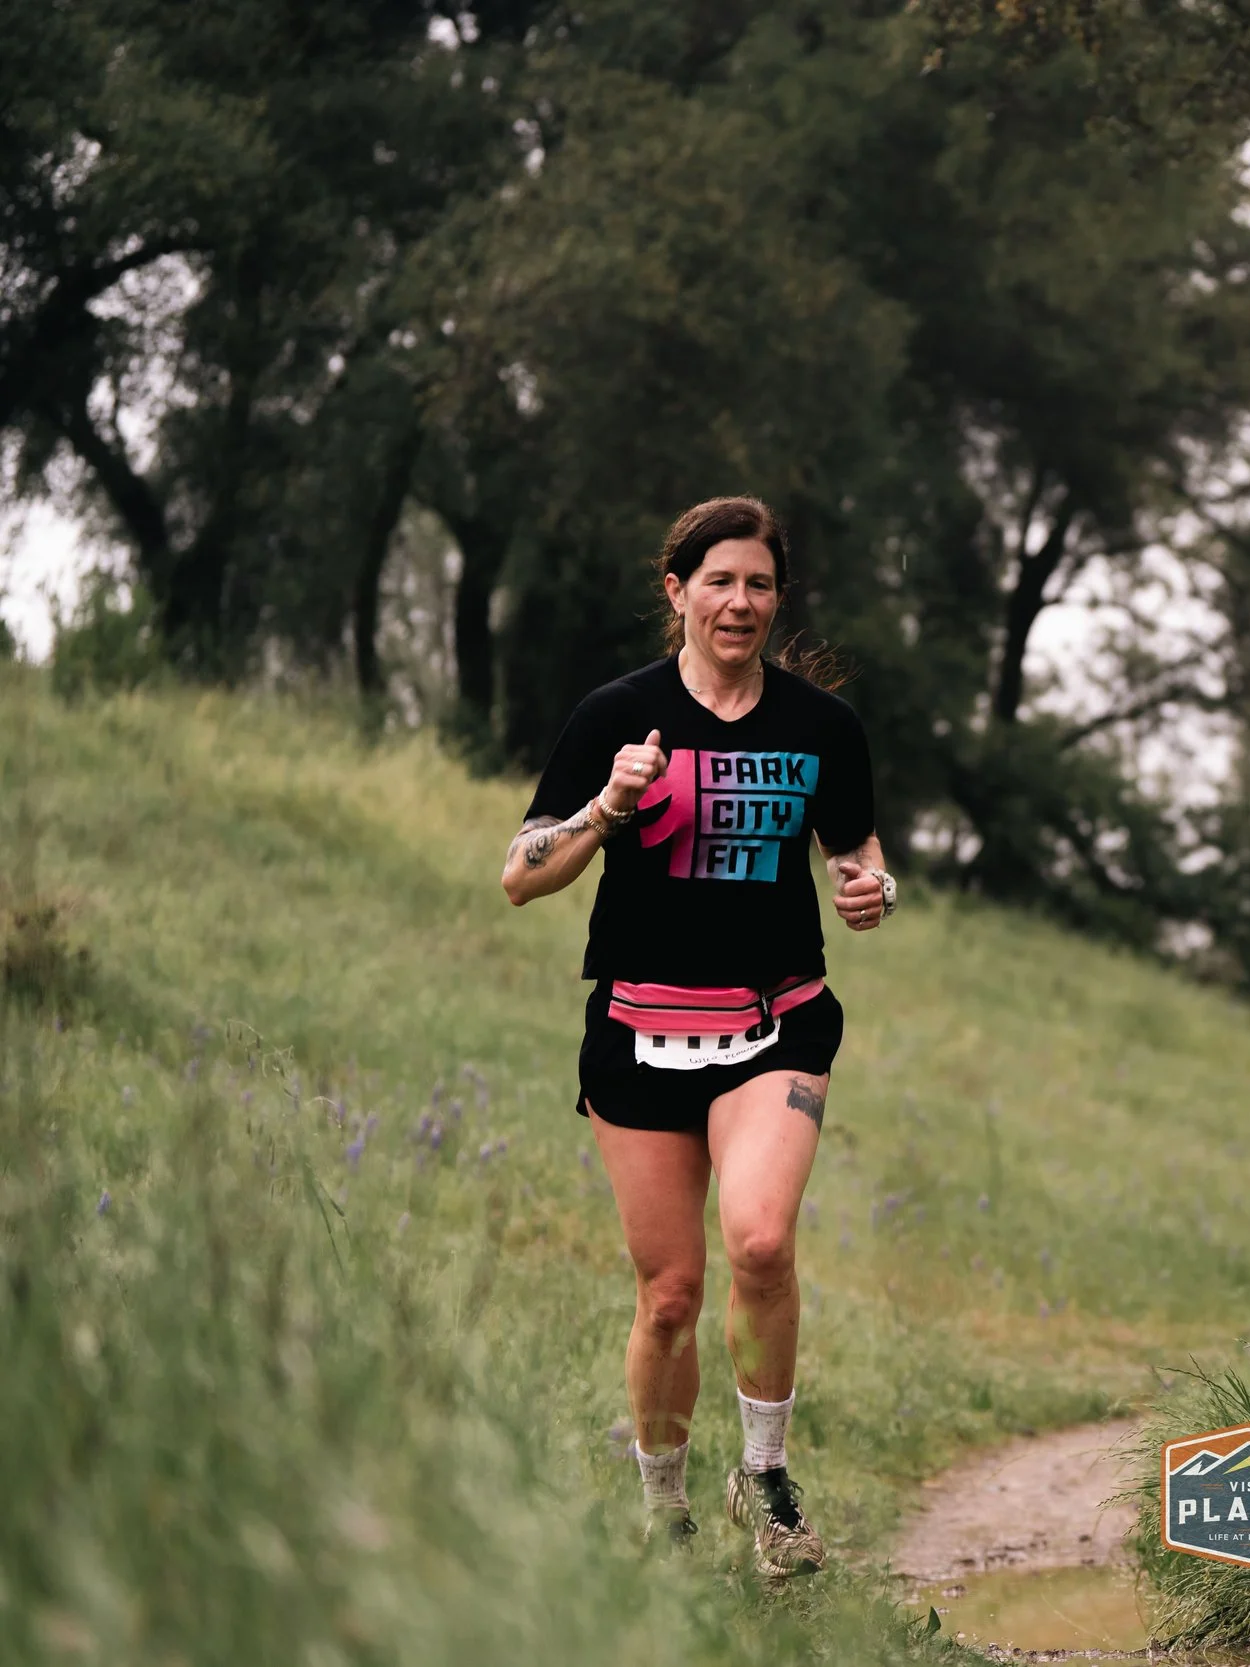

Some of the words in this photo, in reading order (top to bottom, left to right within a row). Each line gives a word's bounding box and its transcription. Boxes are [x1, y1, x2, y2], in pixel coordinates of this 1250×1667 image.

[710, 757, 806, 787] PARK
[711, 800, 792, 830] CITY
[706, 845, 762, 874] FIT
